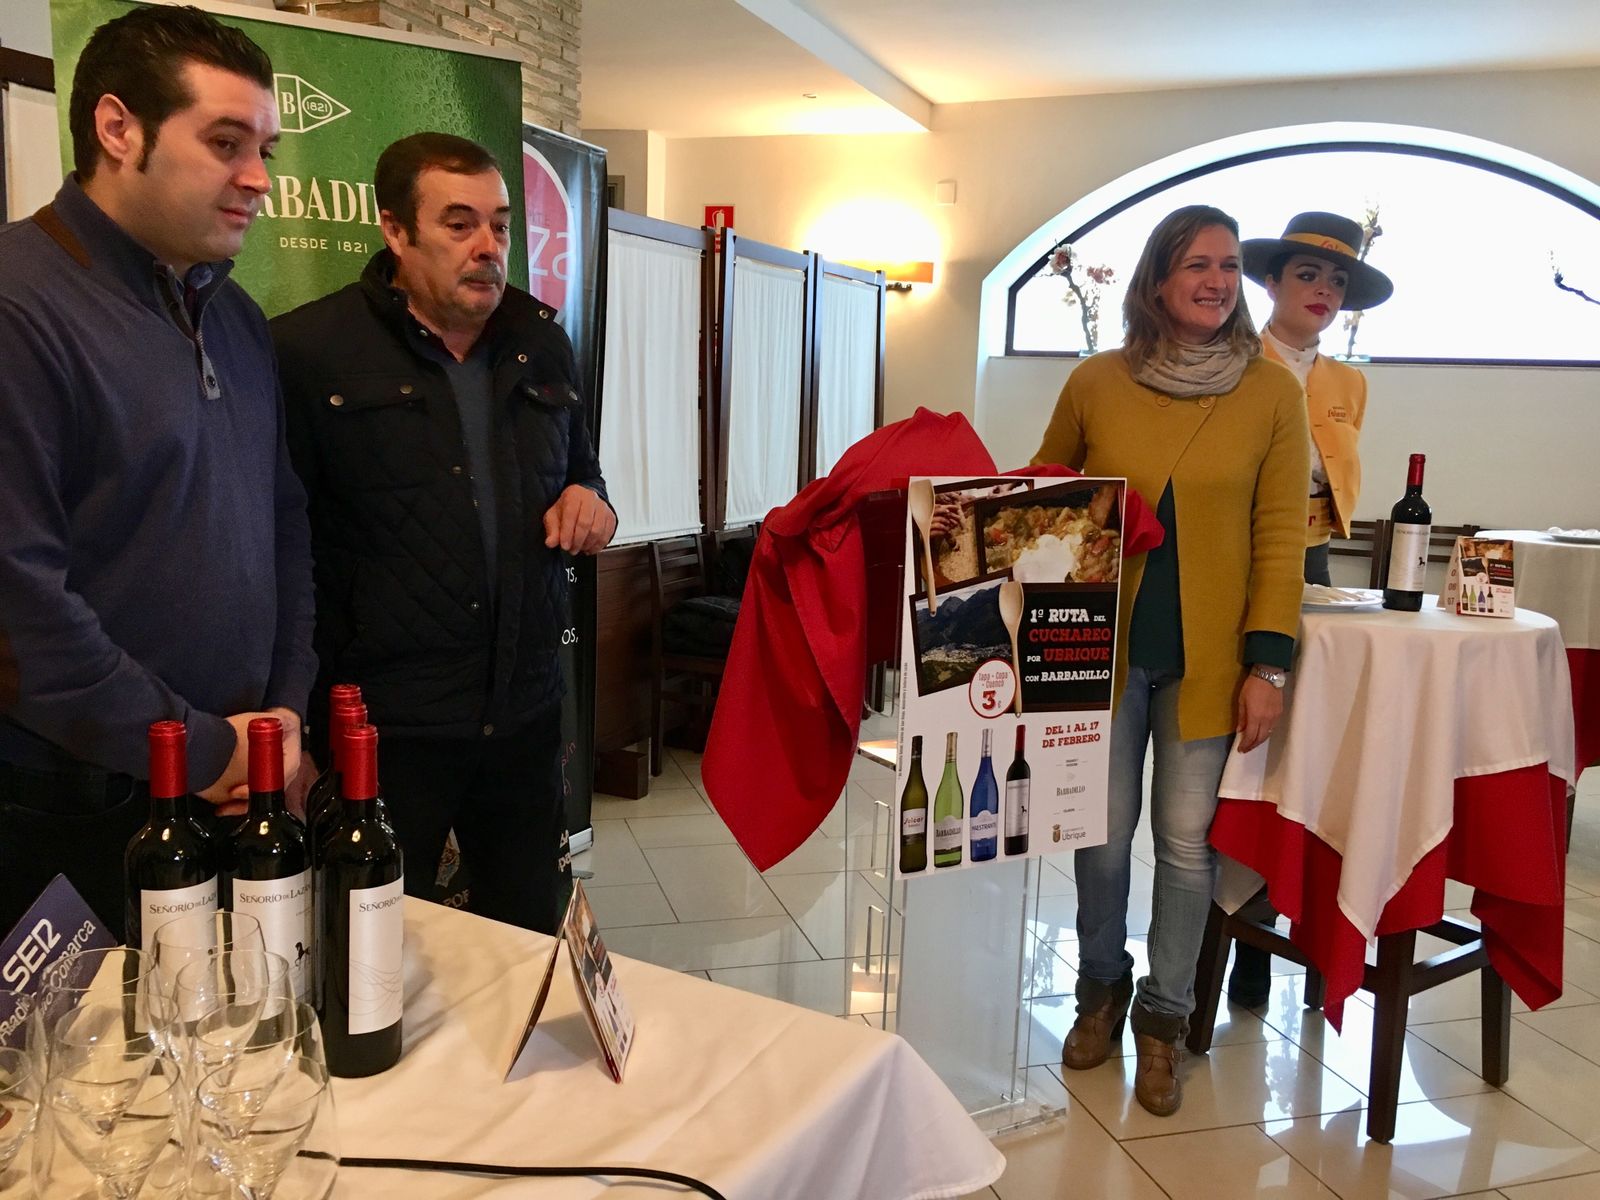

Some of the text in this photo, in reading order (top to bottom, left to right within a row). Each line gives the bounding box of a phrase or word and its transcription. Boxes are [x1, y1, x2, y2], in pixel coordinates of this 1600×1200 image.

[306, 101, 328, 113] 1821
[280, 236, 369, 254] DESDE 1821
[1048, 608, 1090, 623] RUTA
[1029, 628, 1112, 642] CUCHAREO
[1043, 647, 1110, 661] UBRIQUE
[1041, 669, 1110, 682] BARBADILLO
[982, 690, 996, 710] 3
[1045, 721, 1099, 735] DEL 1 AL 17
[1042, 733, 1101, 748] DE FEBRERO
[1062, 832, 1086, 841] Ubrique
